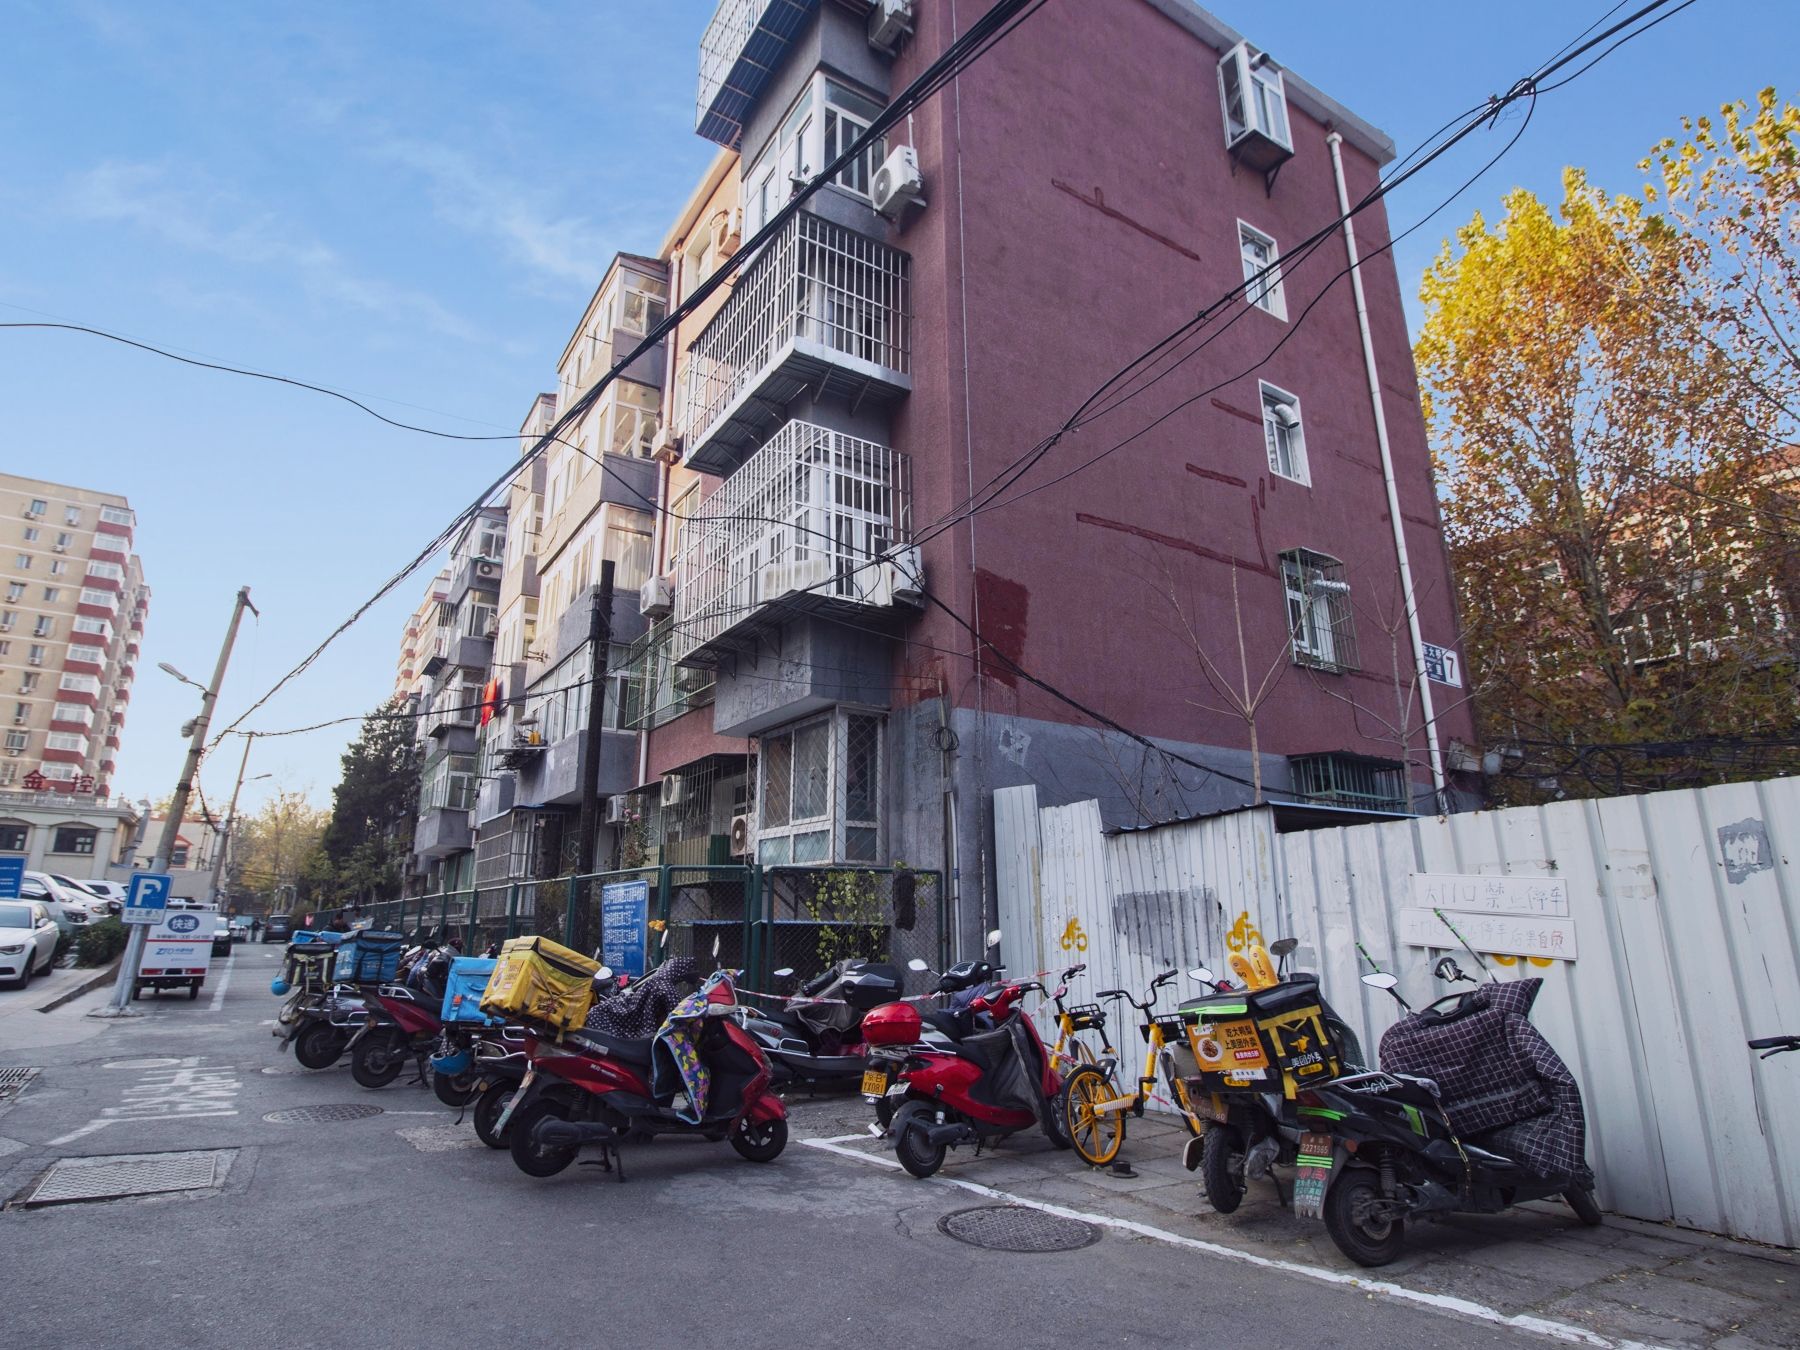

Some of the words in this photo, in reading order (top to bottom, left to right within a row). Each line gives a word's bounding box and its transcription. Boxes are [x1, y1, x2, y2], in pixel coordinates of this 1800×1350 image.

[1446, 655, 1454, 679] 7
[134, 878, 162, 906] P
[1425, 882, 1563, 914] 大门口禁止停车
[171, 917, 196, 930] 快递
[1225, 1037, 1258, 1050] 上美团外卖
